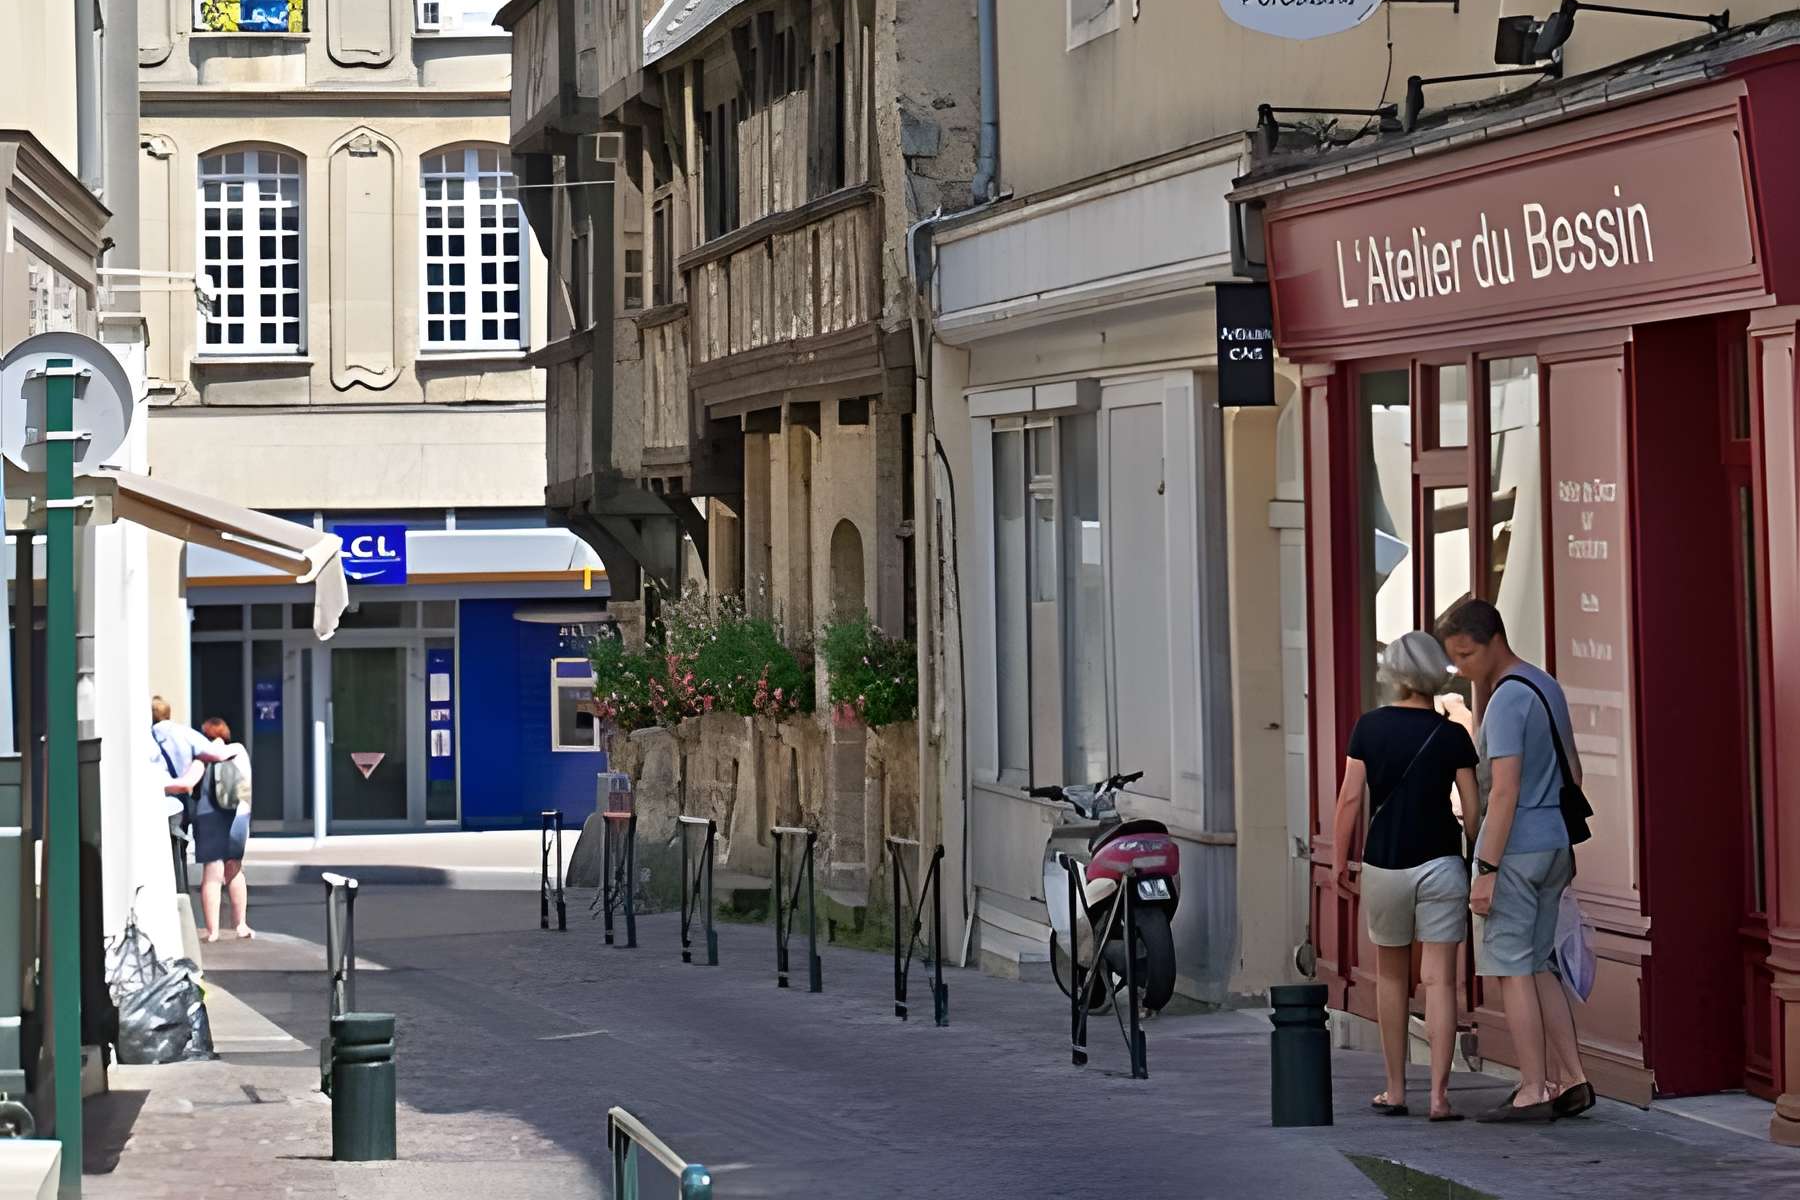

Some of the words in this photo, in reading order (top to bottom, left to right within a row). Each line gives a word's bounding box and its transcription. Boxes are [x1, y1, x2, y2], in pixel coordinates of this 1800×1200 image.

[1337, 226, 1462, 308] L'Atelier
[1472, 212, 1515, 288] du
[1523, 185, 1654, 279] Bessin
